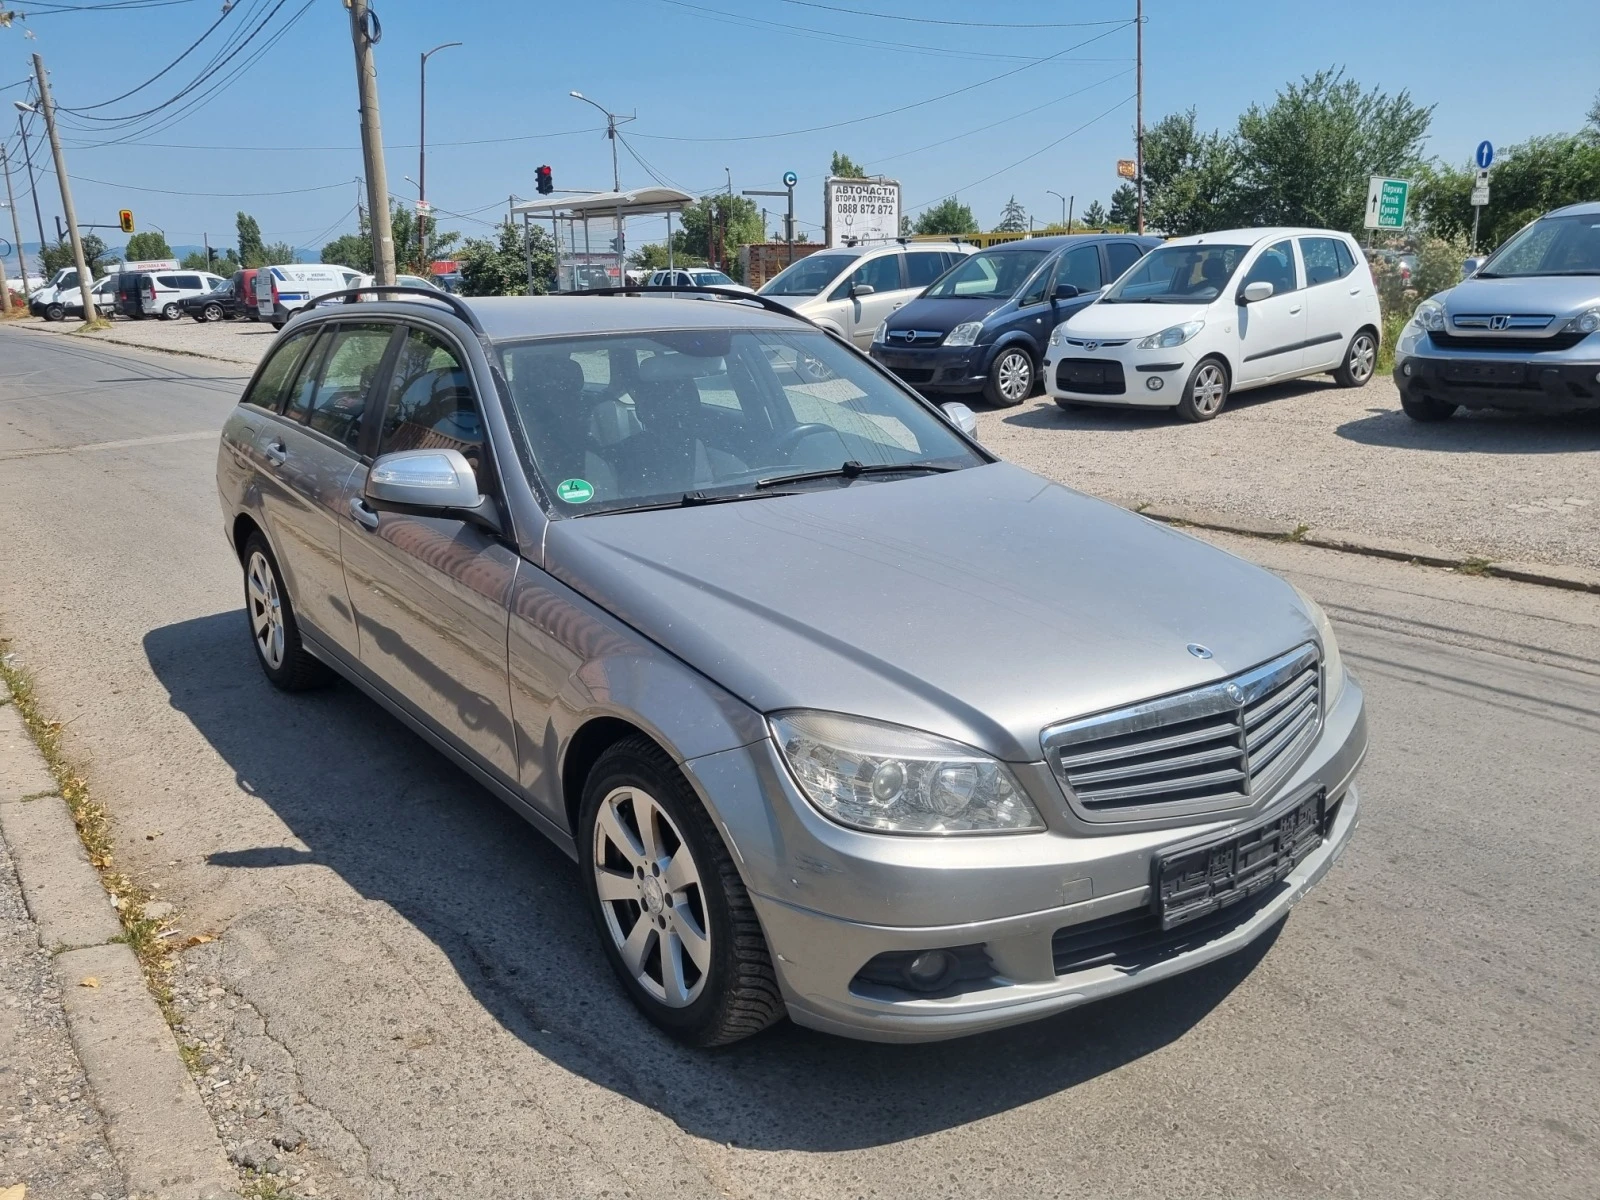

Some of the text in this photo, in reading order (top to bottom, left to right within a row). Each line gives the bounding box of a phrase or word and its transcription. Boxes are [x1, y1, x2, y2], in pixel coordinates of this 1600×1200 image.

[835, 186, 895, 196] АВТОЧАСТИ
[1383, 183, 1403, 195] Перник
[858, 195, 895, 204] УПОТРЕБА
[1382, 194, 1399, 204] Pernik
[837, 203, 893, 215] 0888 872 872
[570, 481, 580, 491] 4
